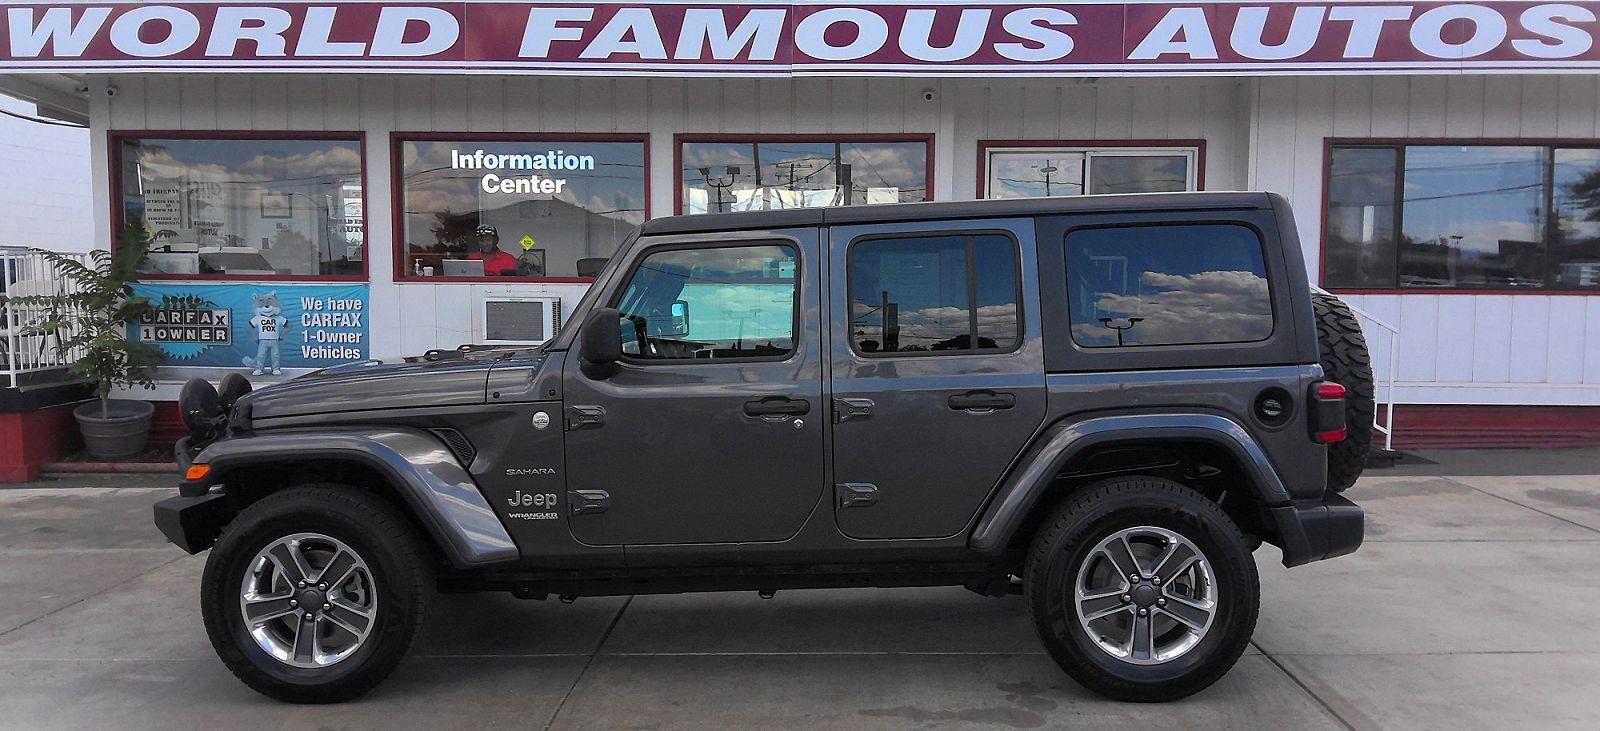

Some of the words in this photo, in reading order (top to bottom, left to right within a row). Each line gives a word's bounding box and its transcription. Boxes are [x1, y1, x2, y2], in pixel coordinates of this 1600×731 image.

[7, 6, 461, 58] WORLD
[517, 7, 1079, 62] FAMOUS
[1126, 4, 1597, 60] AUTOS
[451, 150, 595, 170] Information
[481, 174, 566, 194] Center
[301, 297, 323, 310] We
[327, 297, 363, 310] have
[301, 313, 362, 328] CARFAX
[301, 330, 363, 344] 1-Owner
[302, 346, 361, 360] Vehicles
[506, 468, 556, 476] SAHARA
[507, 490, 558, 509] Jeep
